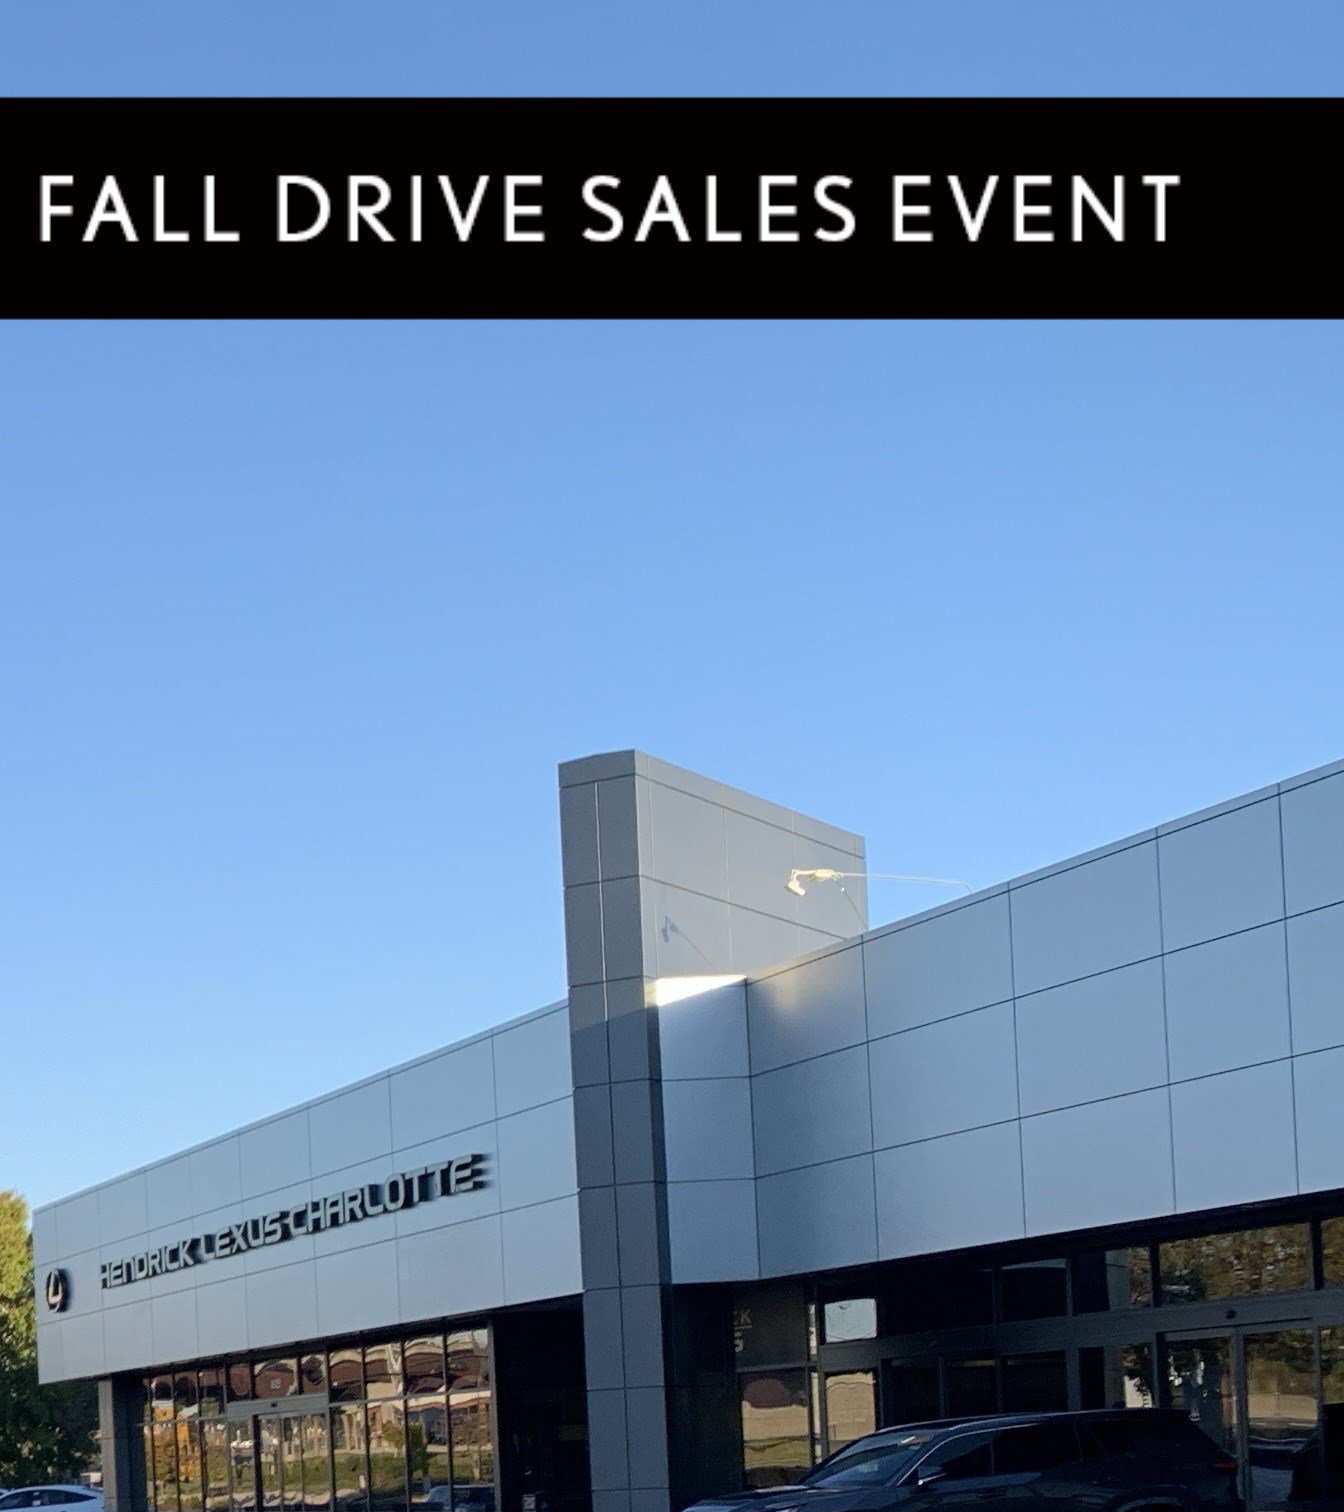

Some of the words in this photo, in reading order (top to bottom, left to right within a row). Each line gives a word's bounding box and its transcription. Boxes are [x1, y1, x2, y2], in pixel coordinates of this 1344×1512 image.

[99, 1238, 196, 1289] HENDRICK
[198, 1212, 285, 1264] LEXUS
[289, 1153, 488, 1237] CHARLOTTE
